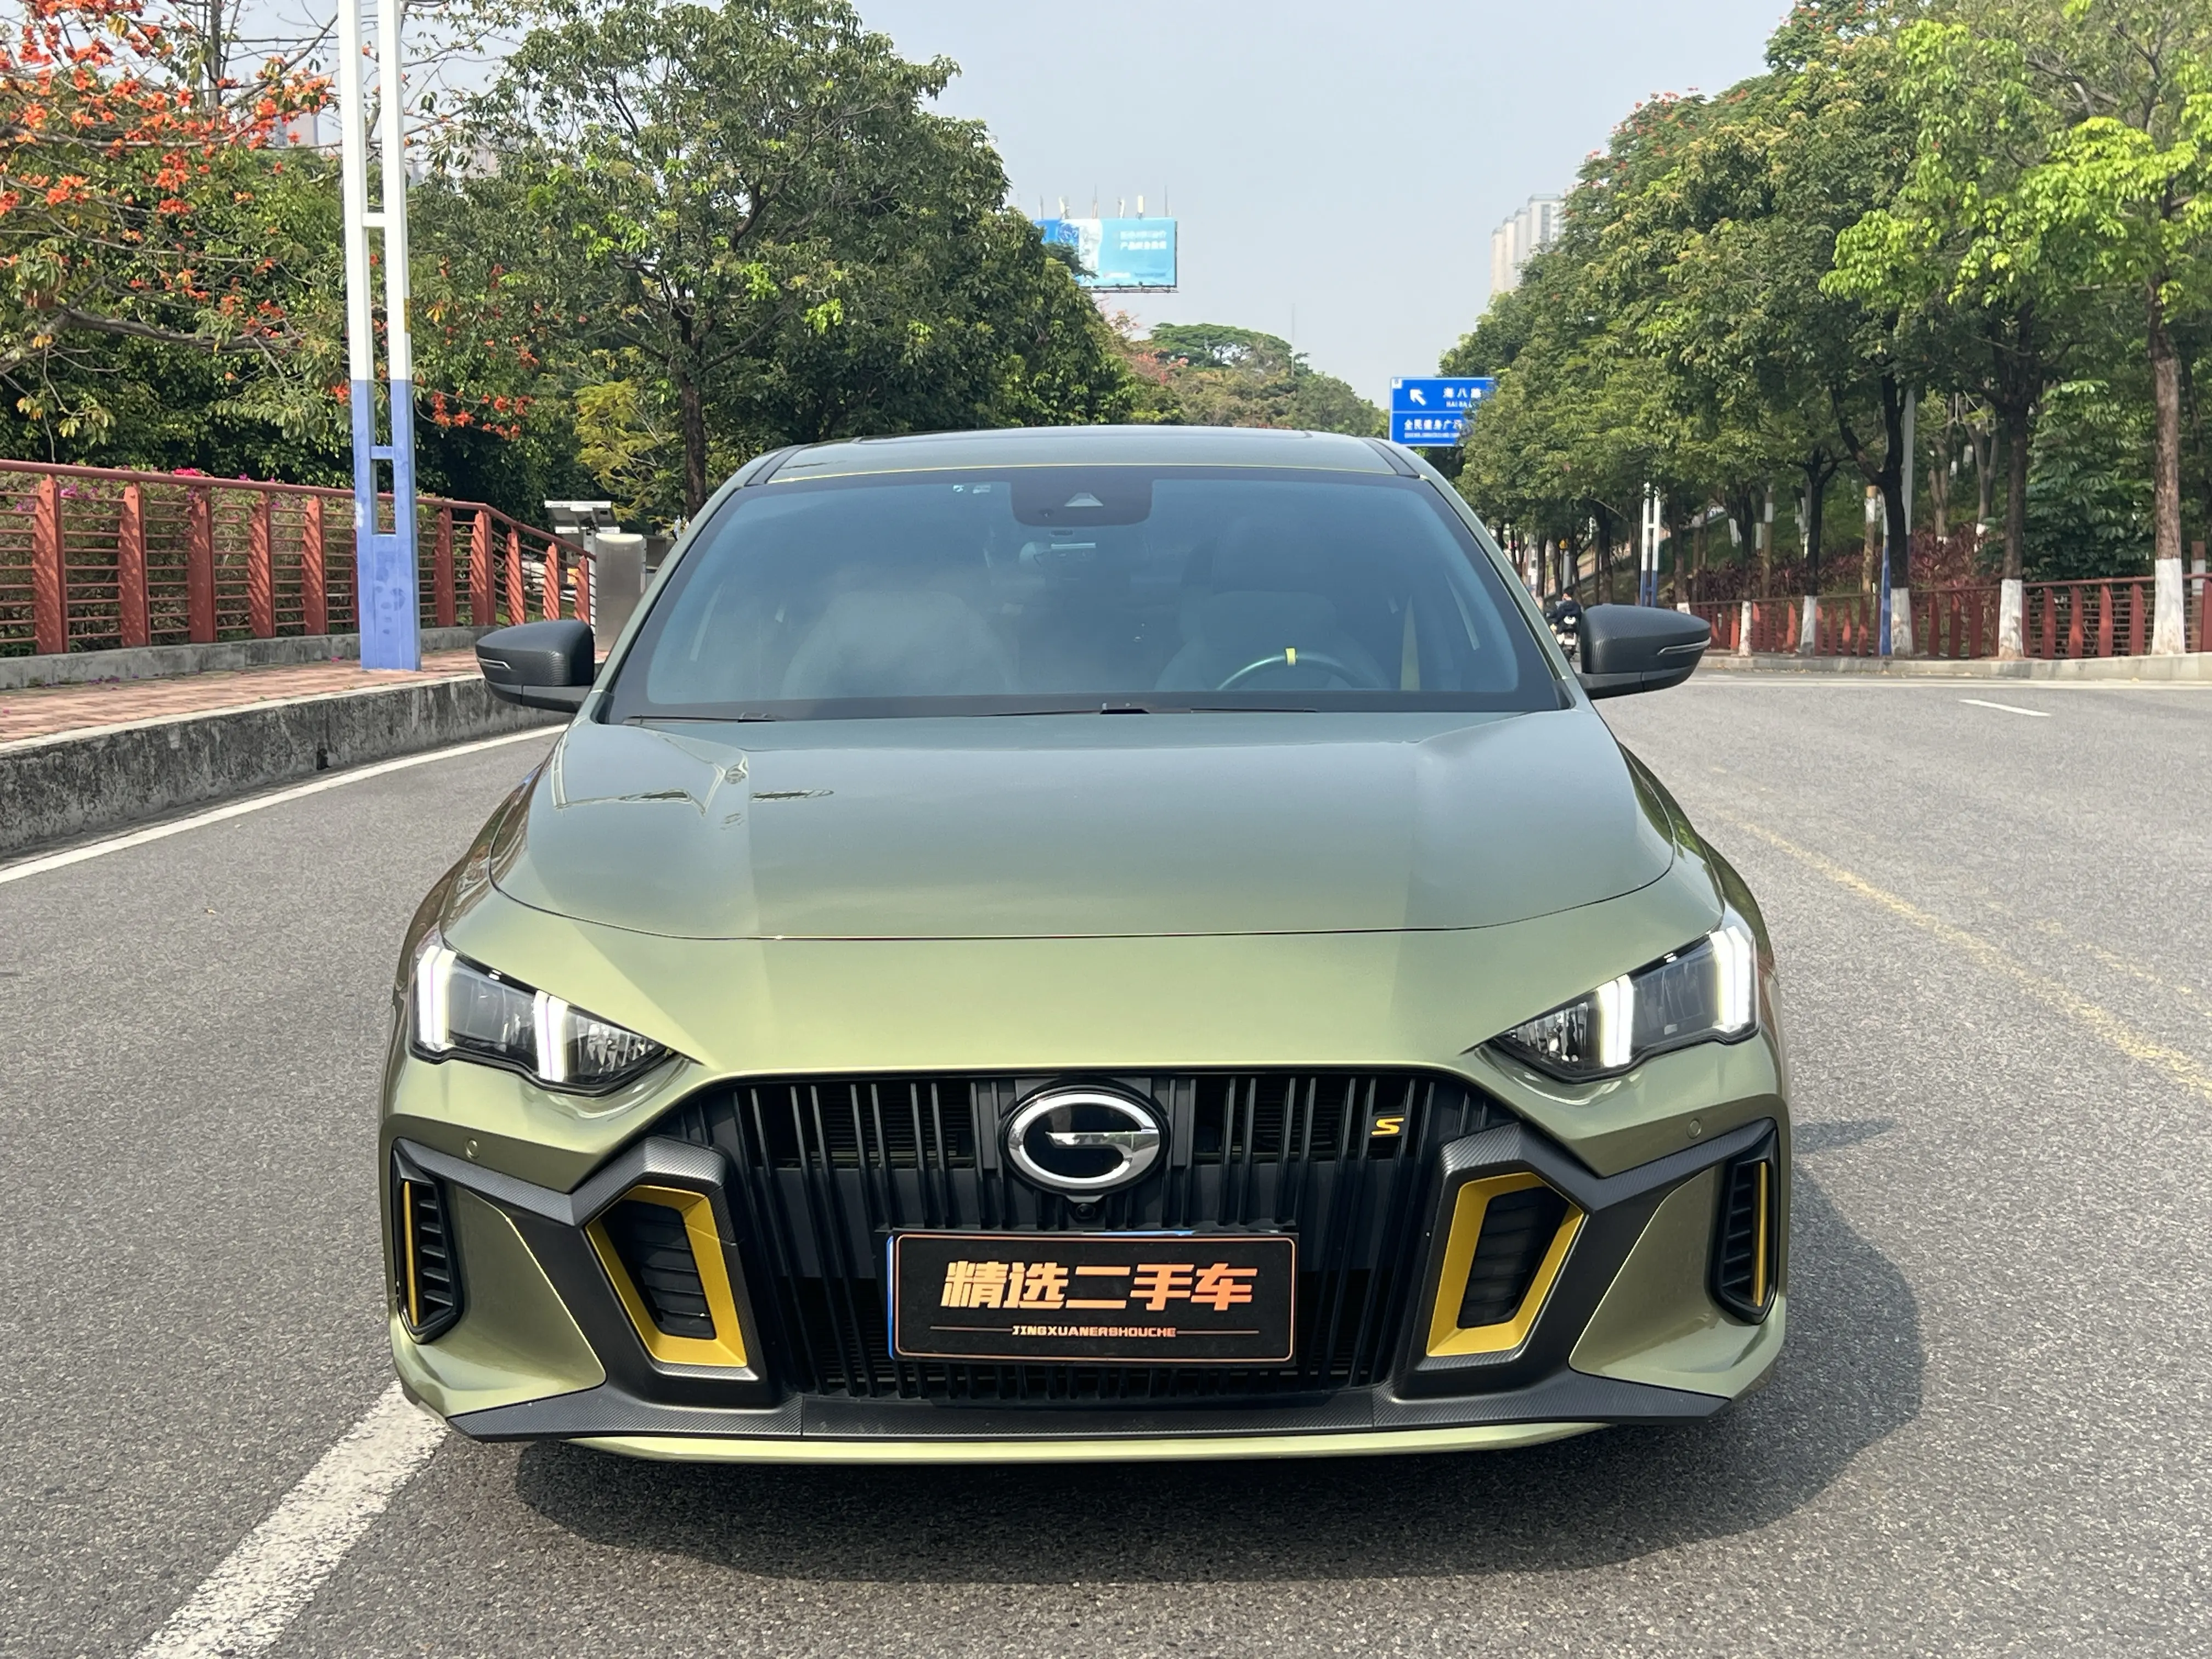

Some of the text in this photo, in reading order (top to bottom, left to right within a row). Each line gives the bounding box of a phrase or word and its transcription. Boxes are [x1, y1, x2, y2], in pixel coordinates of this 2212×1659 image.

[1372, 1118, 1404, 1136] S
[940, 1261, 1258, 1311] 精选二手车
